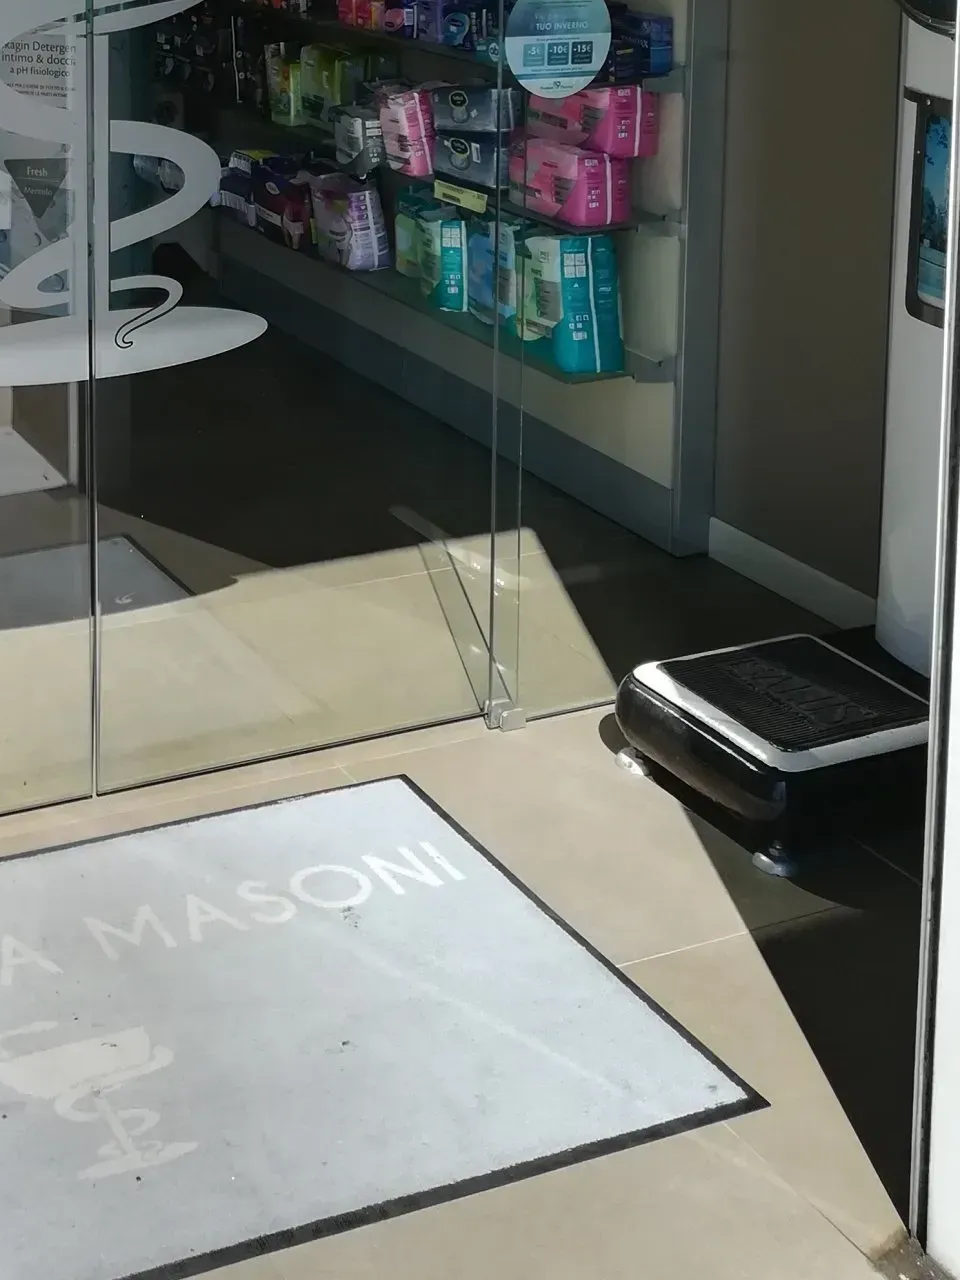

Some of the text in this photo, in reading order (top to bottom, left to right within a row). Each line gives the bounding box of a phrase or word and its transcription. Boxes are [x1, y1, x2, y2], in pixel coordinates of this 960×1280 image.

[535, 20, 589, 31] TUO INVERNO
[1, 52, 34, 64] intimo
[35, 53, 44, 64] &
[16, 66, 28, 76] pH
[30, 66, 71, 78] fisiologico
[26, 166, 48, 177] Fresh
[88, 840, 468, 963] MASONI
